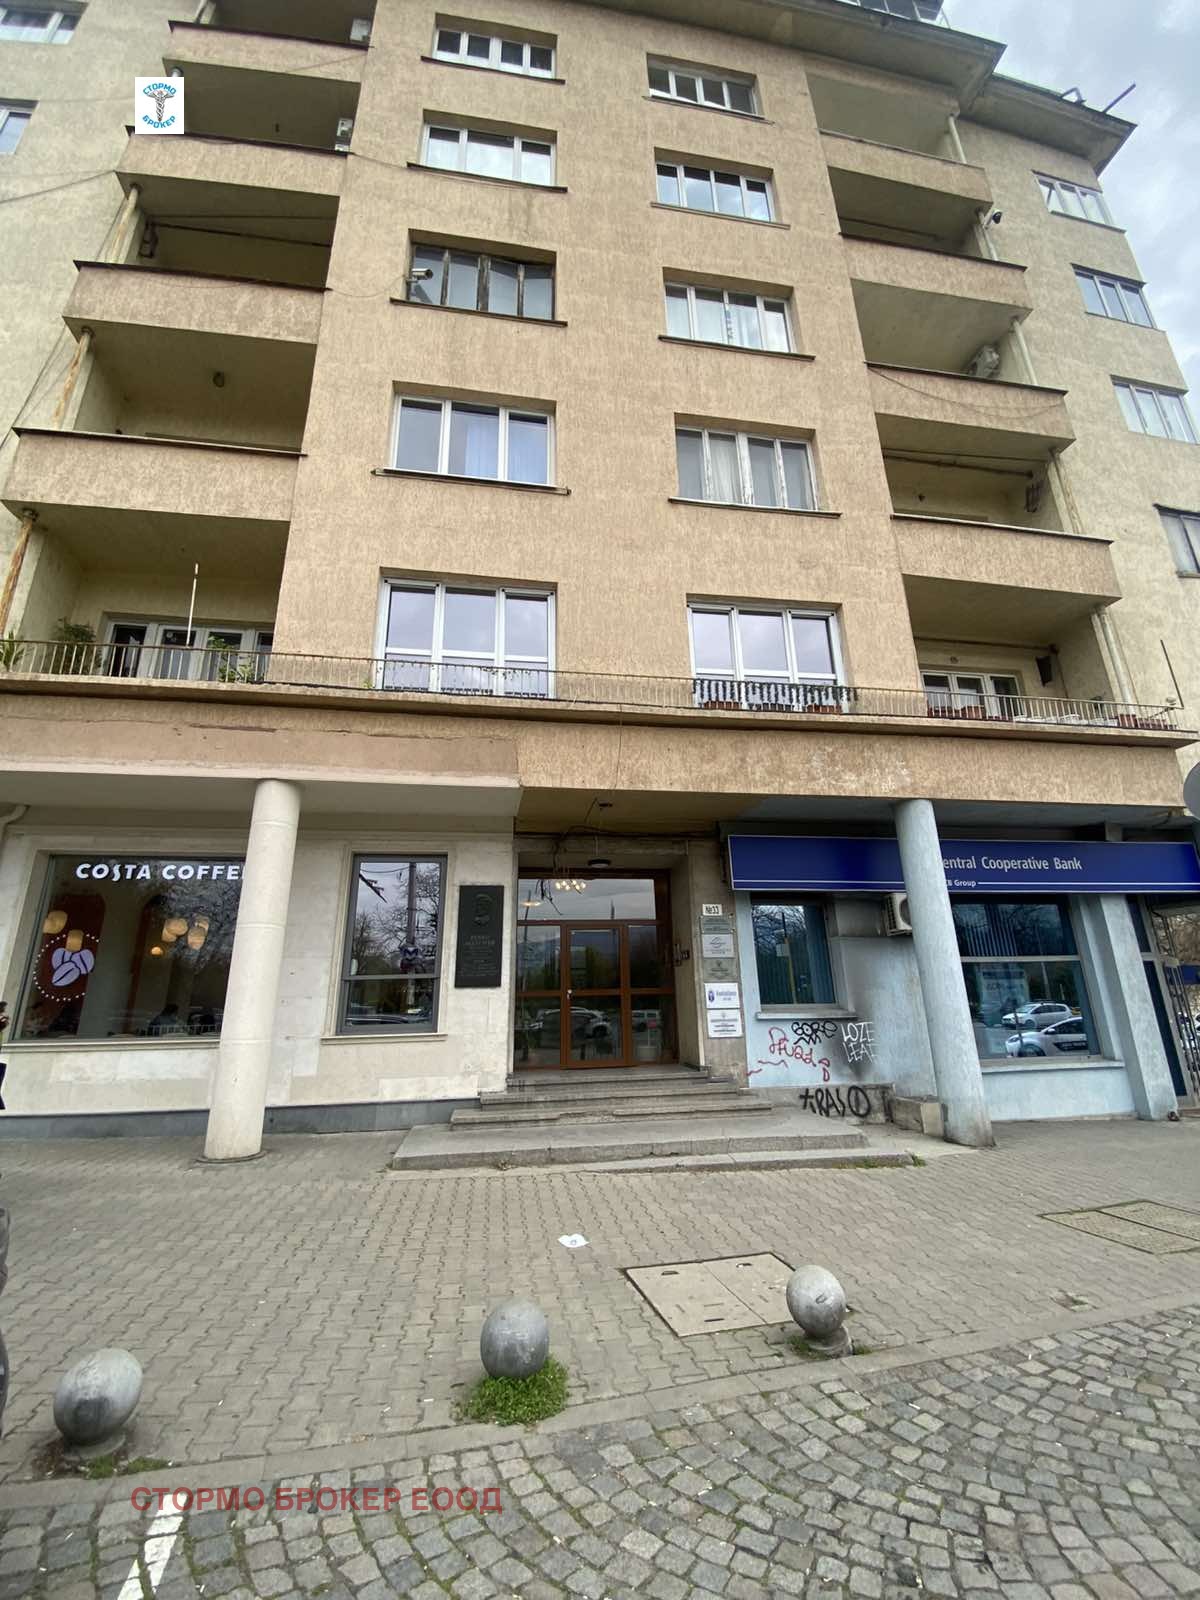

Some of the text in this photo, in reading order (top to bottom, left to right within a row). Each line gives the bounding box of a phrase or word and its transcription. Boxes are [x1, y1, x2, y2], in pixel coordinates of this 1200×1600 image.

[942, 856, 1083, 872] entral Cooperative Bank
[75, 863, 245, 882] COSTA COFFE
[953, 879, 977, 888] Group
